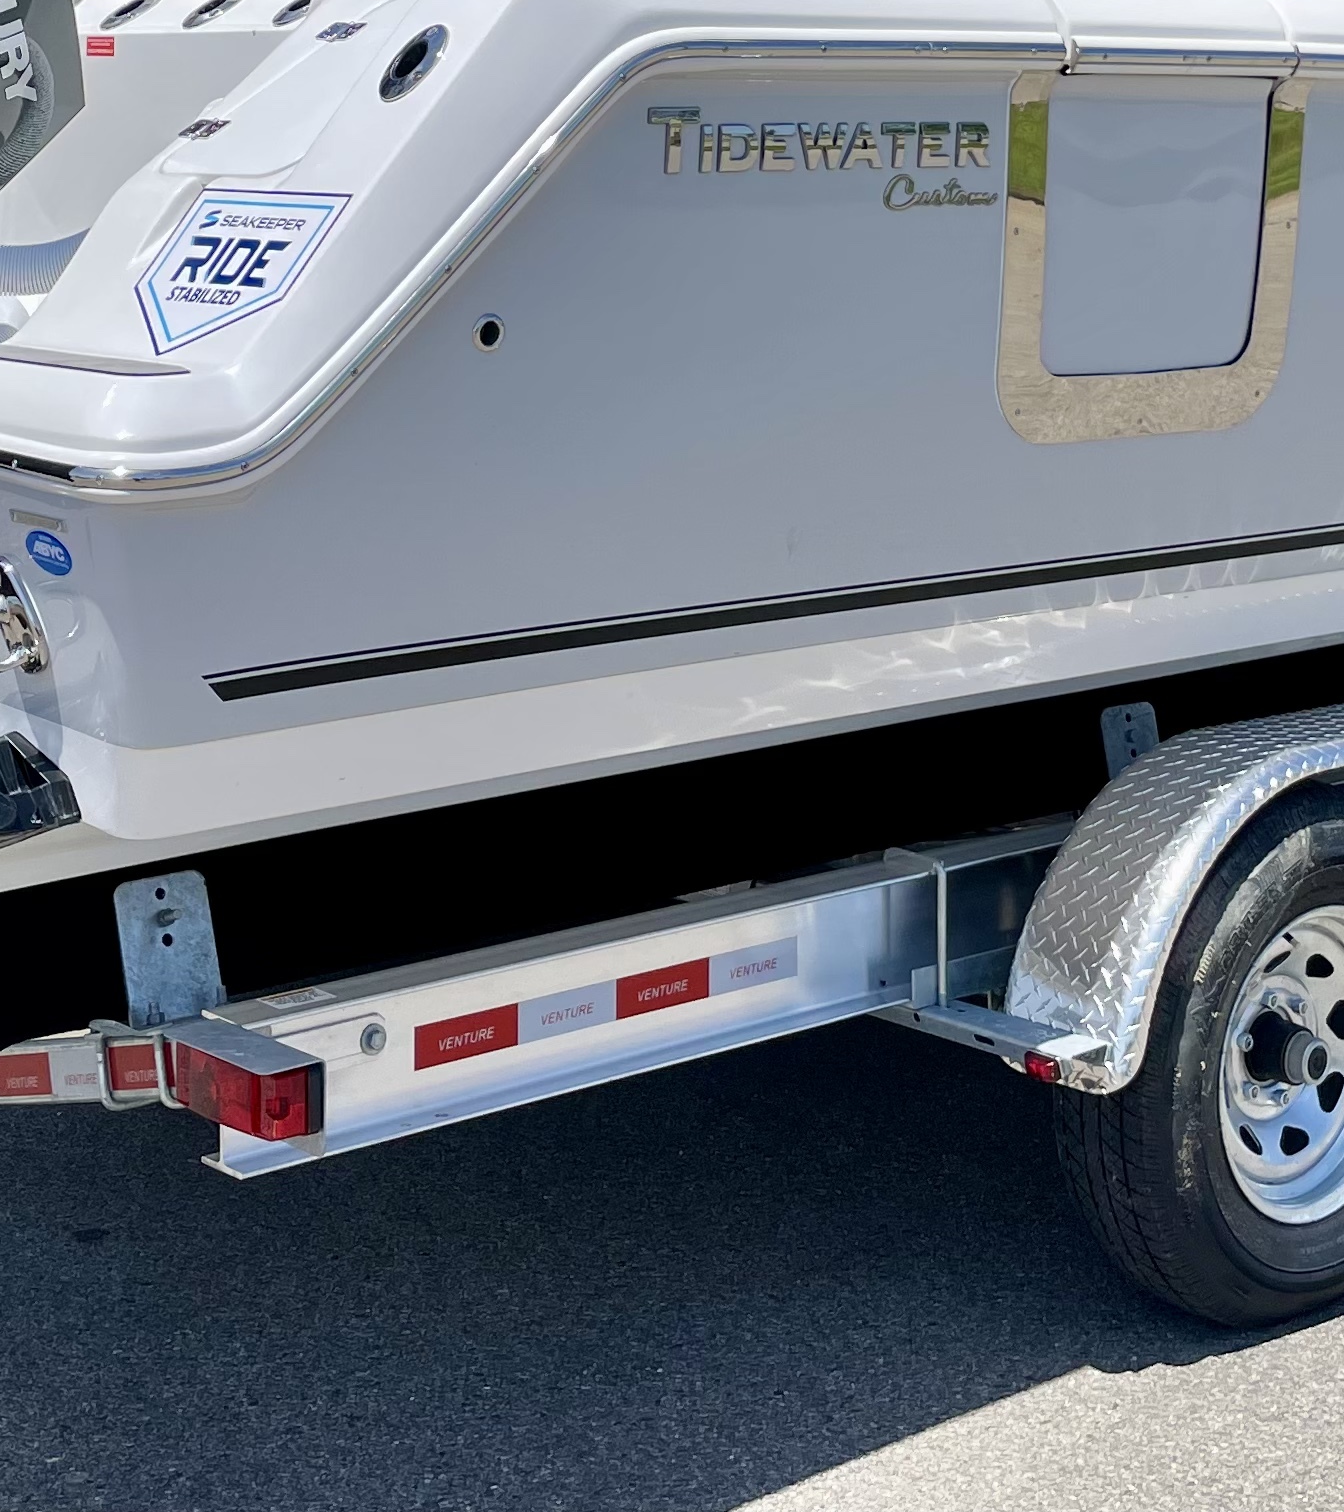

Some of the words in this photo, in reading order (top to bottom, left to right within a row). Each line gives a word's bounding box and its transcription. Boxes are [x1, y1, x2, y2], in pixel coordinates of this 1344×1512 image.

[647, 106, 991, 174] TIDEWATER
[883, 173, 999, 211] Custom
[219, 214, 307, 232] SEAKEEPER
[169, 235, 293, 288] RIDE
[165, 286, 242, 306] STABILIZED
[729, 956, 778, 980] VENTURE
[636, 978, 689, 1003] VENTURE
[540, 1002, 594, 1026] VENTURE
[437, 1025, 495, 1052] VENTURE
[5, 1075, 39, 1089] VENTURE
[64, 1072, 98, 1086] VENTURE
